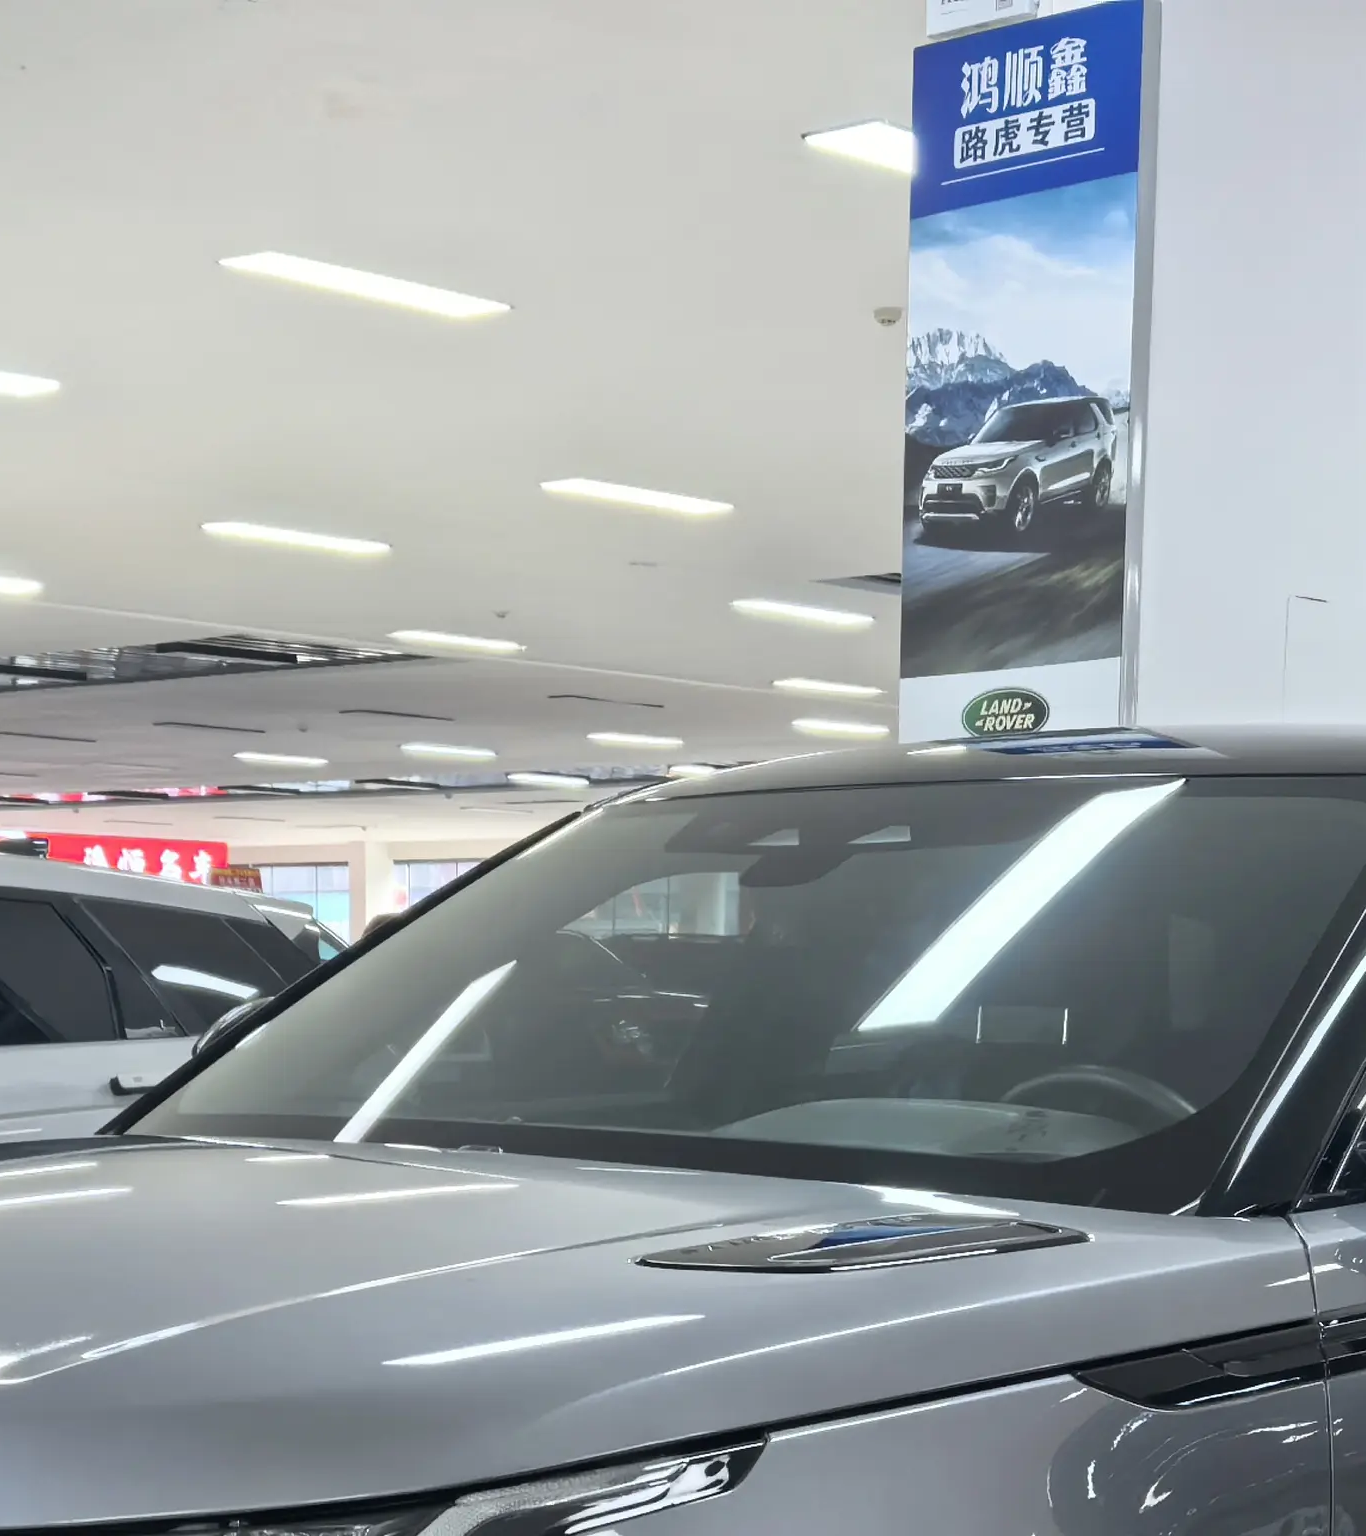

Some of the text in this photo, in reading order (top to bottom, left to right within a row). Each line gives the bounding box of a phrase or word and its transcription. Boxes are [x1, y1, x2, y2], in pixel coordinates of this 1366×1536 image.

[960, 36, 1087, 119] 鸿顺鑫
[959, 103, 1090, 164] 路虎专营
[980, 698, 1022, 715] LAND
[983, 713, 1035, 731] ROVER
